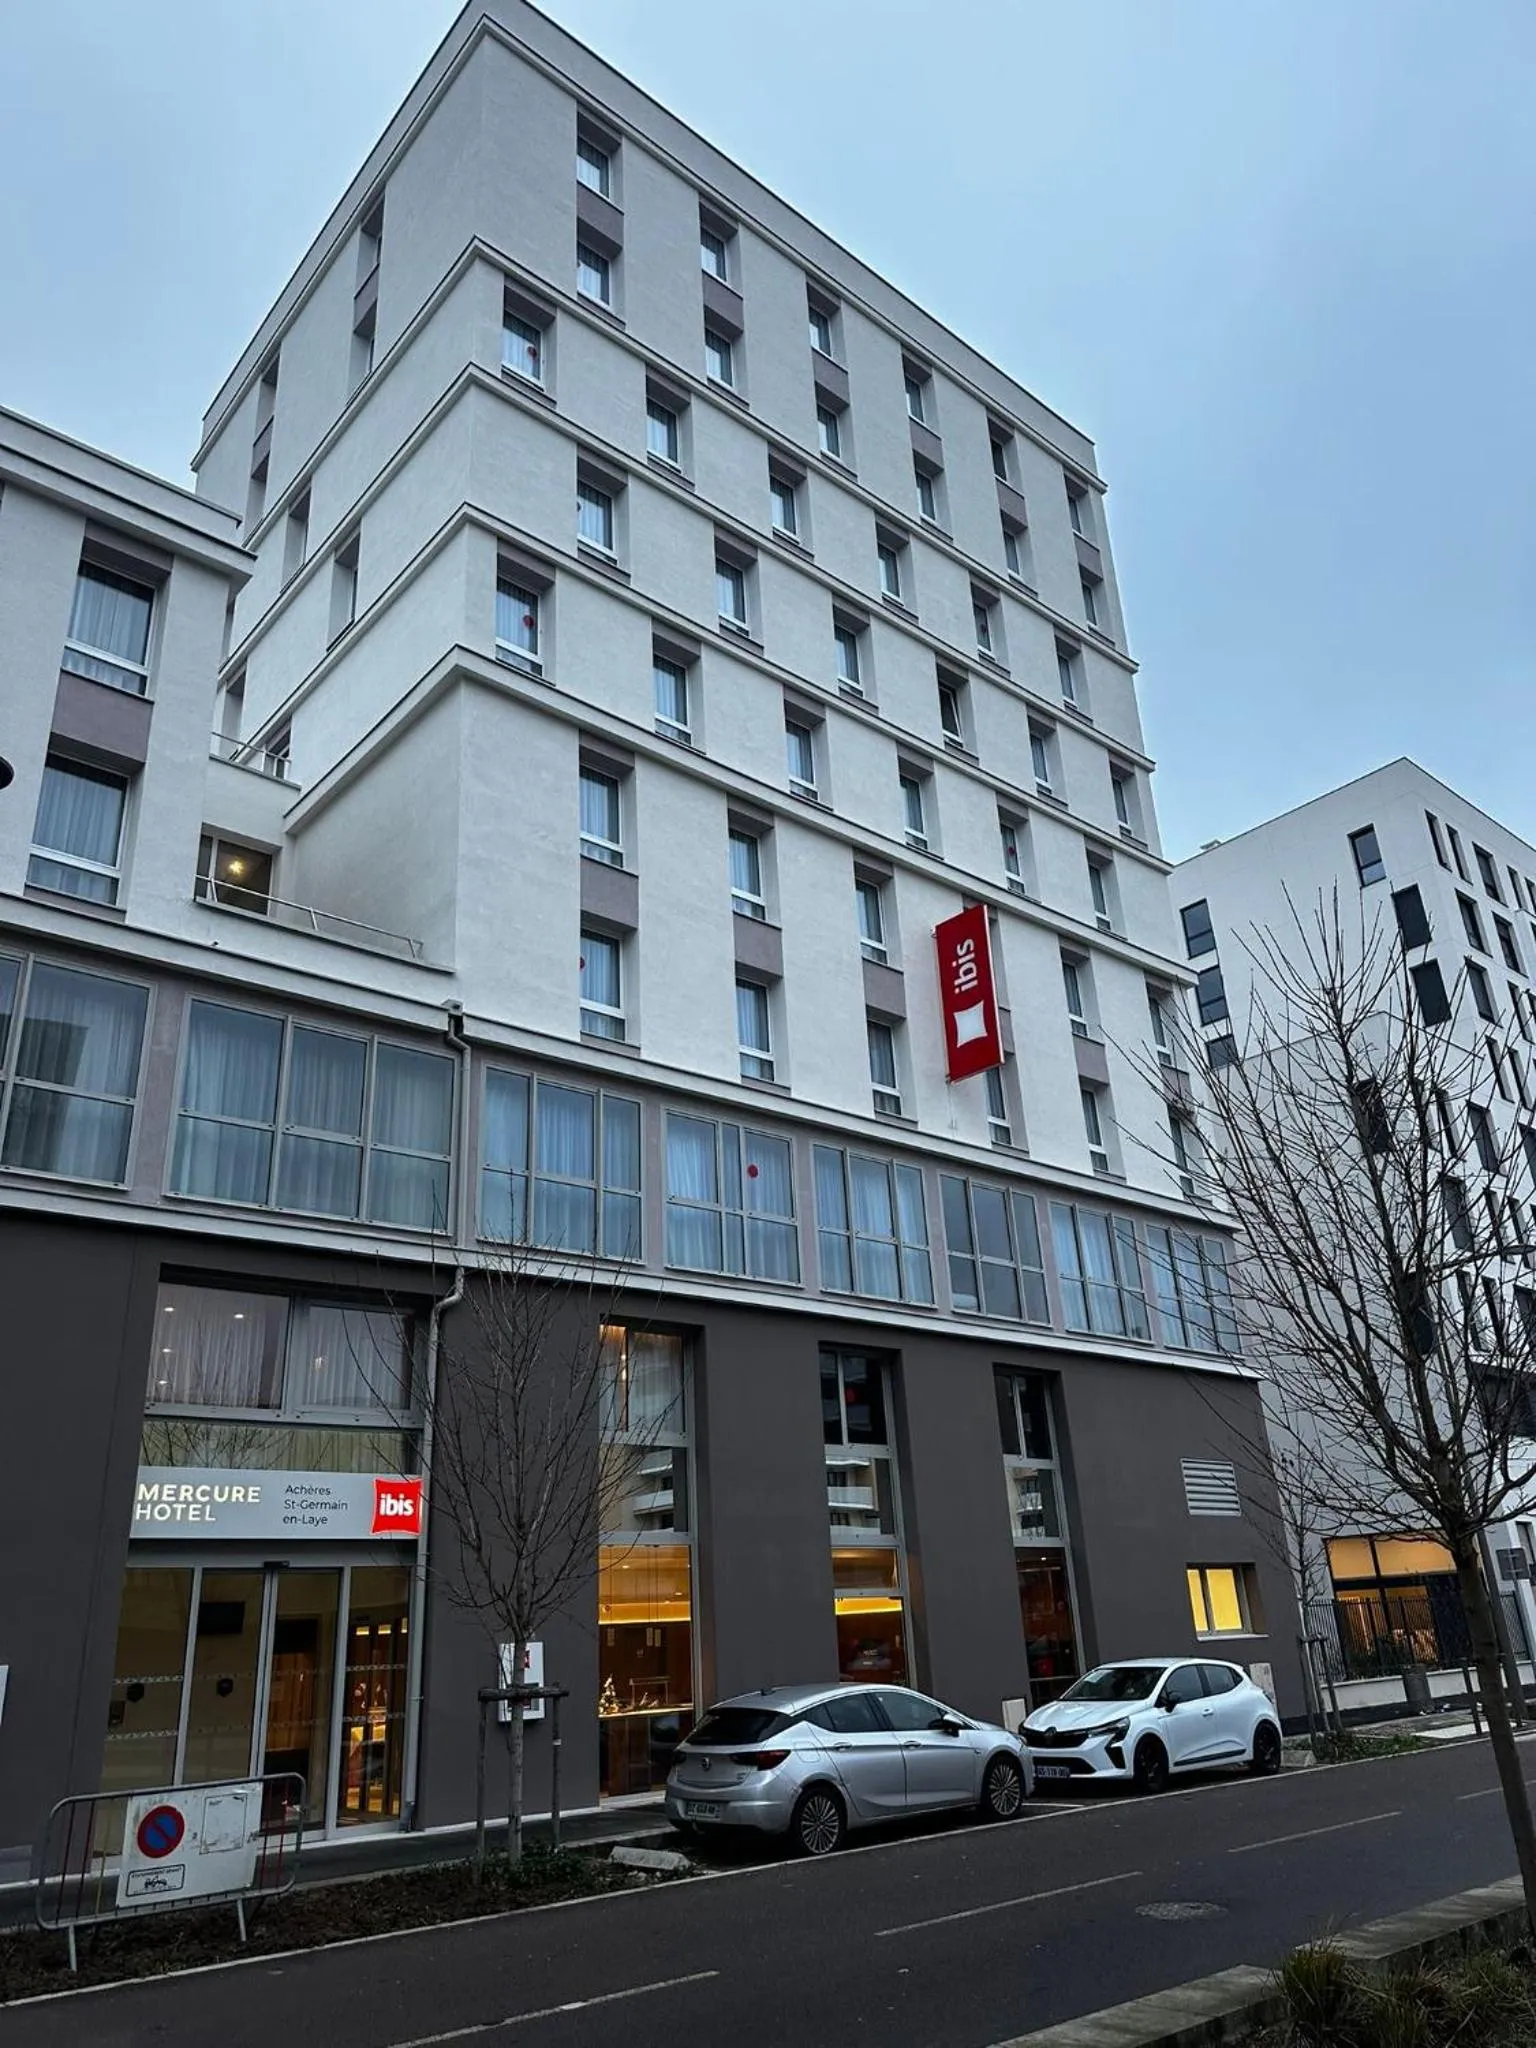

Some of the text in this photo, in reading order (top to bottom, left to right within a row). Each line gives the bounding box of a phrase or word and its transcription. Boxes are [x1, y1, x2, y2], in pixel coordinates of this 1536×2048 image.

[952, 939, 978, 994] ibis
[138, 1483, 261, 1503] MERCURE
[285, 1485, 331, 1496] Achères
[136, 1503, 216, 1521] HOTEL
[284, 1499, 348, 1511] St-Germain
[380, 1494, 413, 1516] ibis
[282, 1514, 328, 1527] en-Laye
